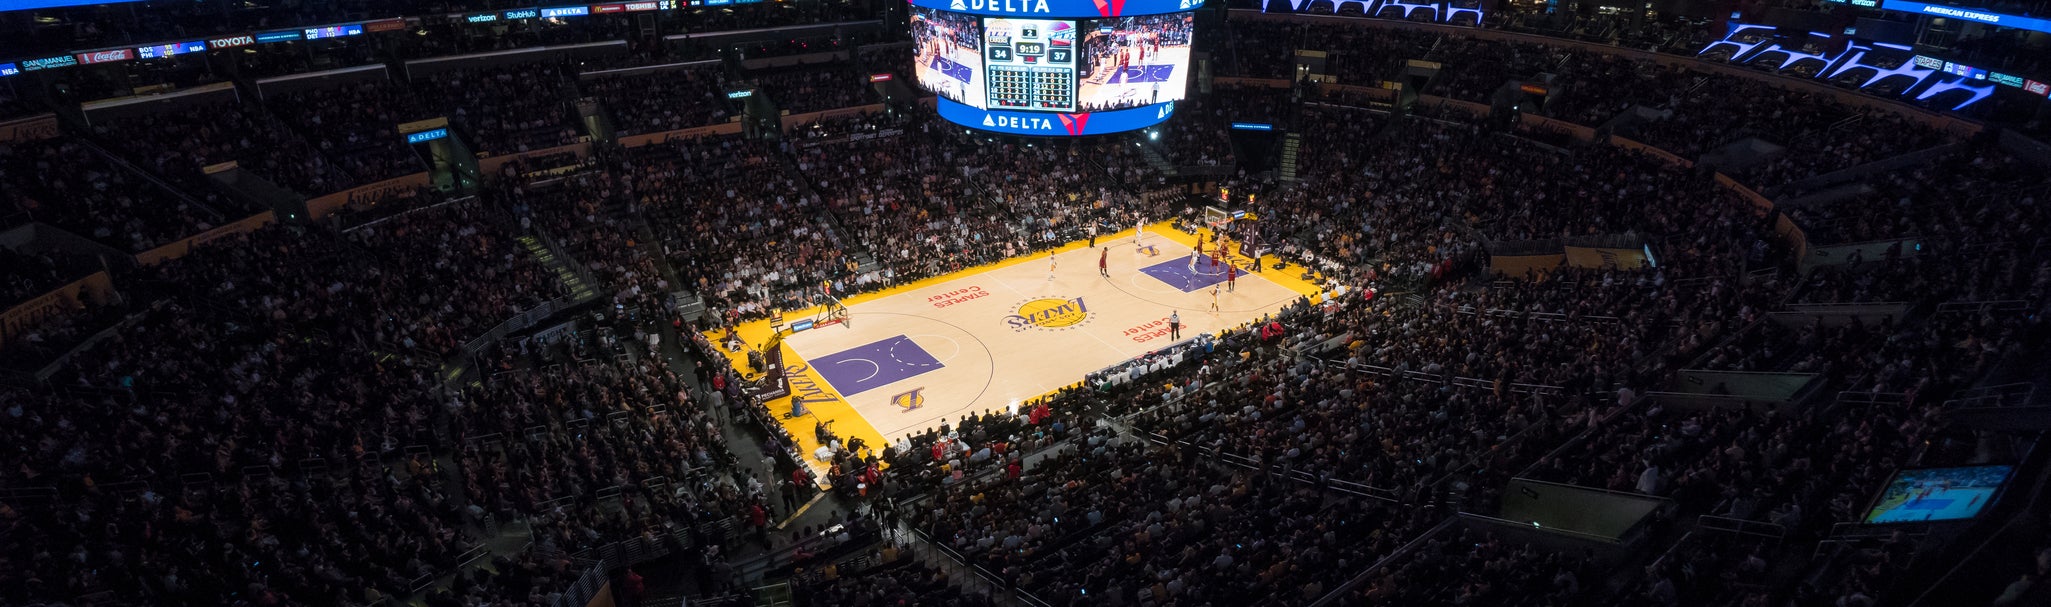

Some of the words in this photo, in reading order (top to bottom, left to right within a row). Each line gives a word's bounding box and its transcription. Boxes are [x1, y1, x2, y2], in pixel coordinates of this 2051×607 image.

[971, 0, 1050, 12] DELTA
[468, 14, 496, 22] verizon
[506, 11, 536, 19] StubHub
[1923, 6, 1964, 17] AMERICAN
[1964, 12, 2000, 22] EXPRESS
[210, 36, 254, 48] TOYOTA
[44, 56, 76, 64] MANUEL
[94, 50, 125, 62] Coca-Cola
[994, 50, 1006, 58] 34
[1054, 52, 1066, 60] 37
[1915, 55, 1941, 70] STAPLES
[998, 115, 1052, 130] DELTA
[418, 130, 446, 140] DELTA
[928, 286, 980, 302] Center
[934, 291, 990, 308] STAPLES
[1000, 297, 1088, 327] LAKERS
[1133, 324, 1186, 343] SAPLES
